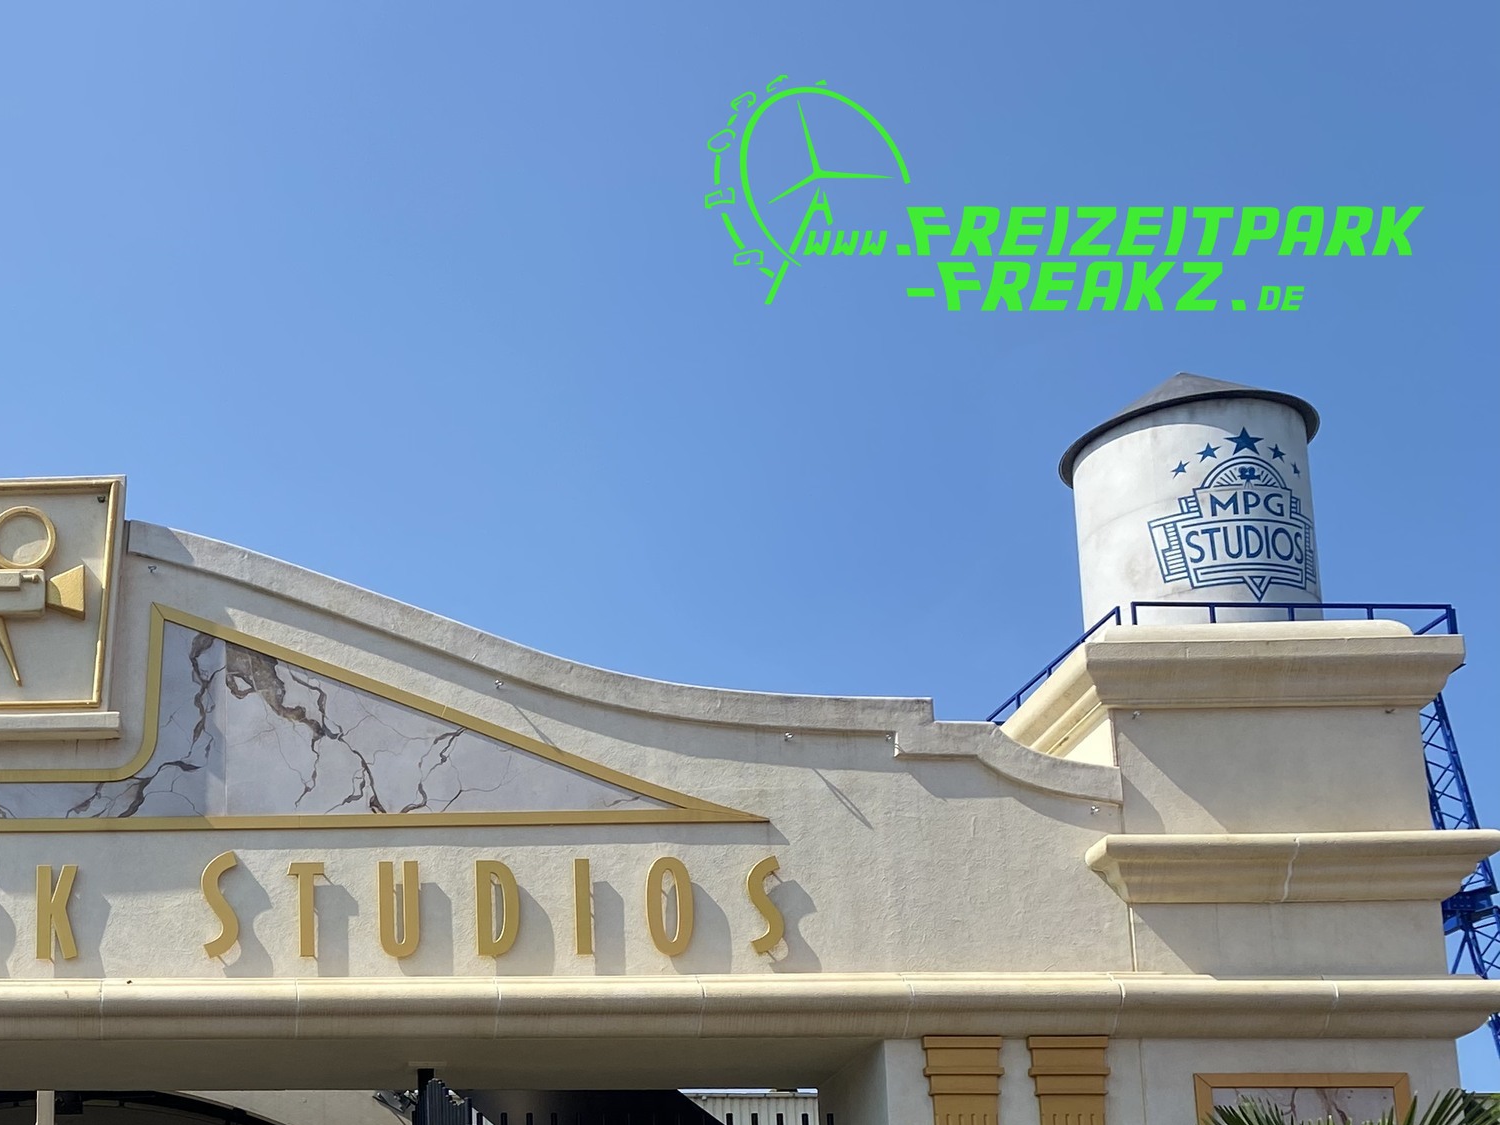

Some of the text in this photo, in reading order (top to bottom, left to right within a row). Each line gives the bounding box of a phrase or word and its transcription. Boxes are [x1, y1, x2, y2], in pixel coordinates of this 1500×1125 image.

[1209, 490, 1285, 518] MPG
[1185, 525, 1305, 565] STUDIOS
[200, 850, 786, 960] STUDIOS
